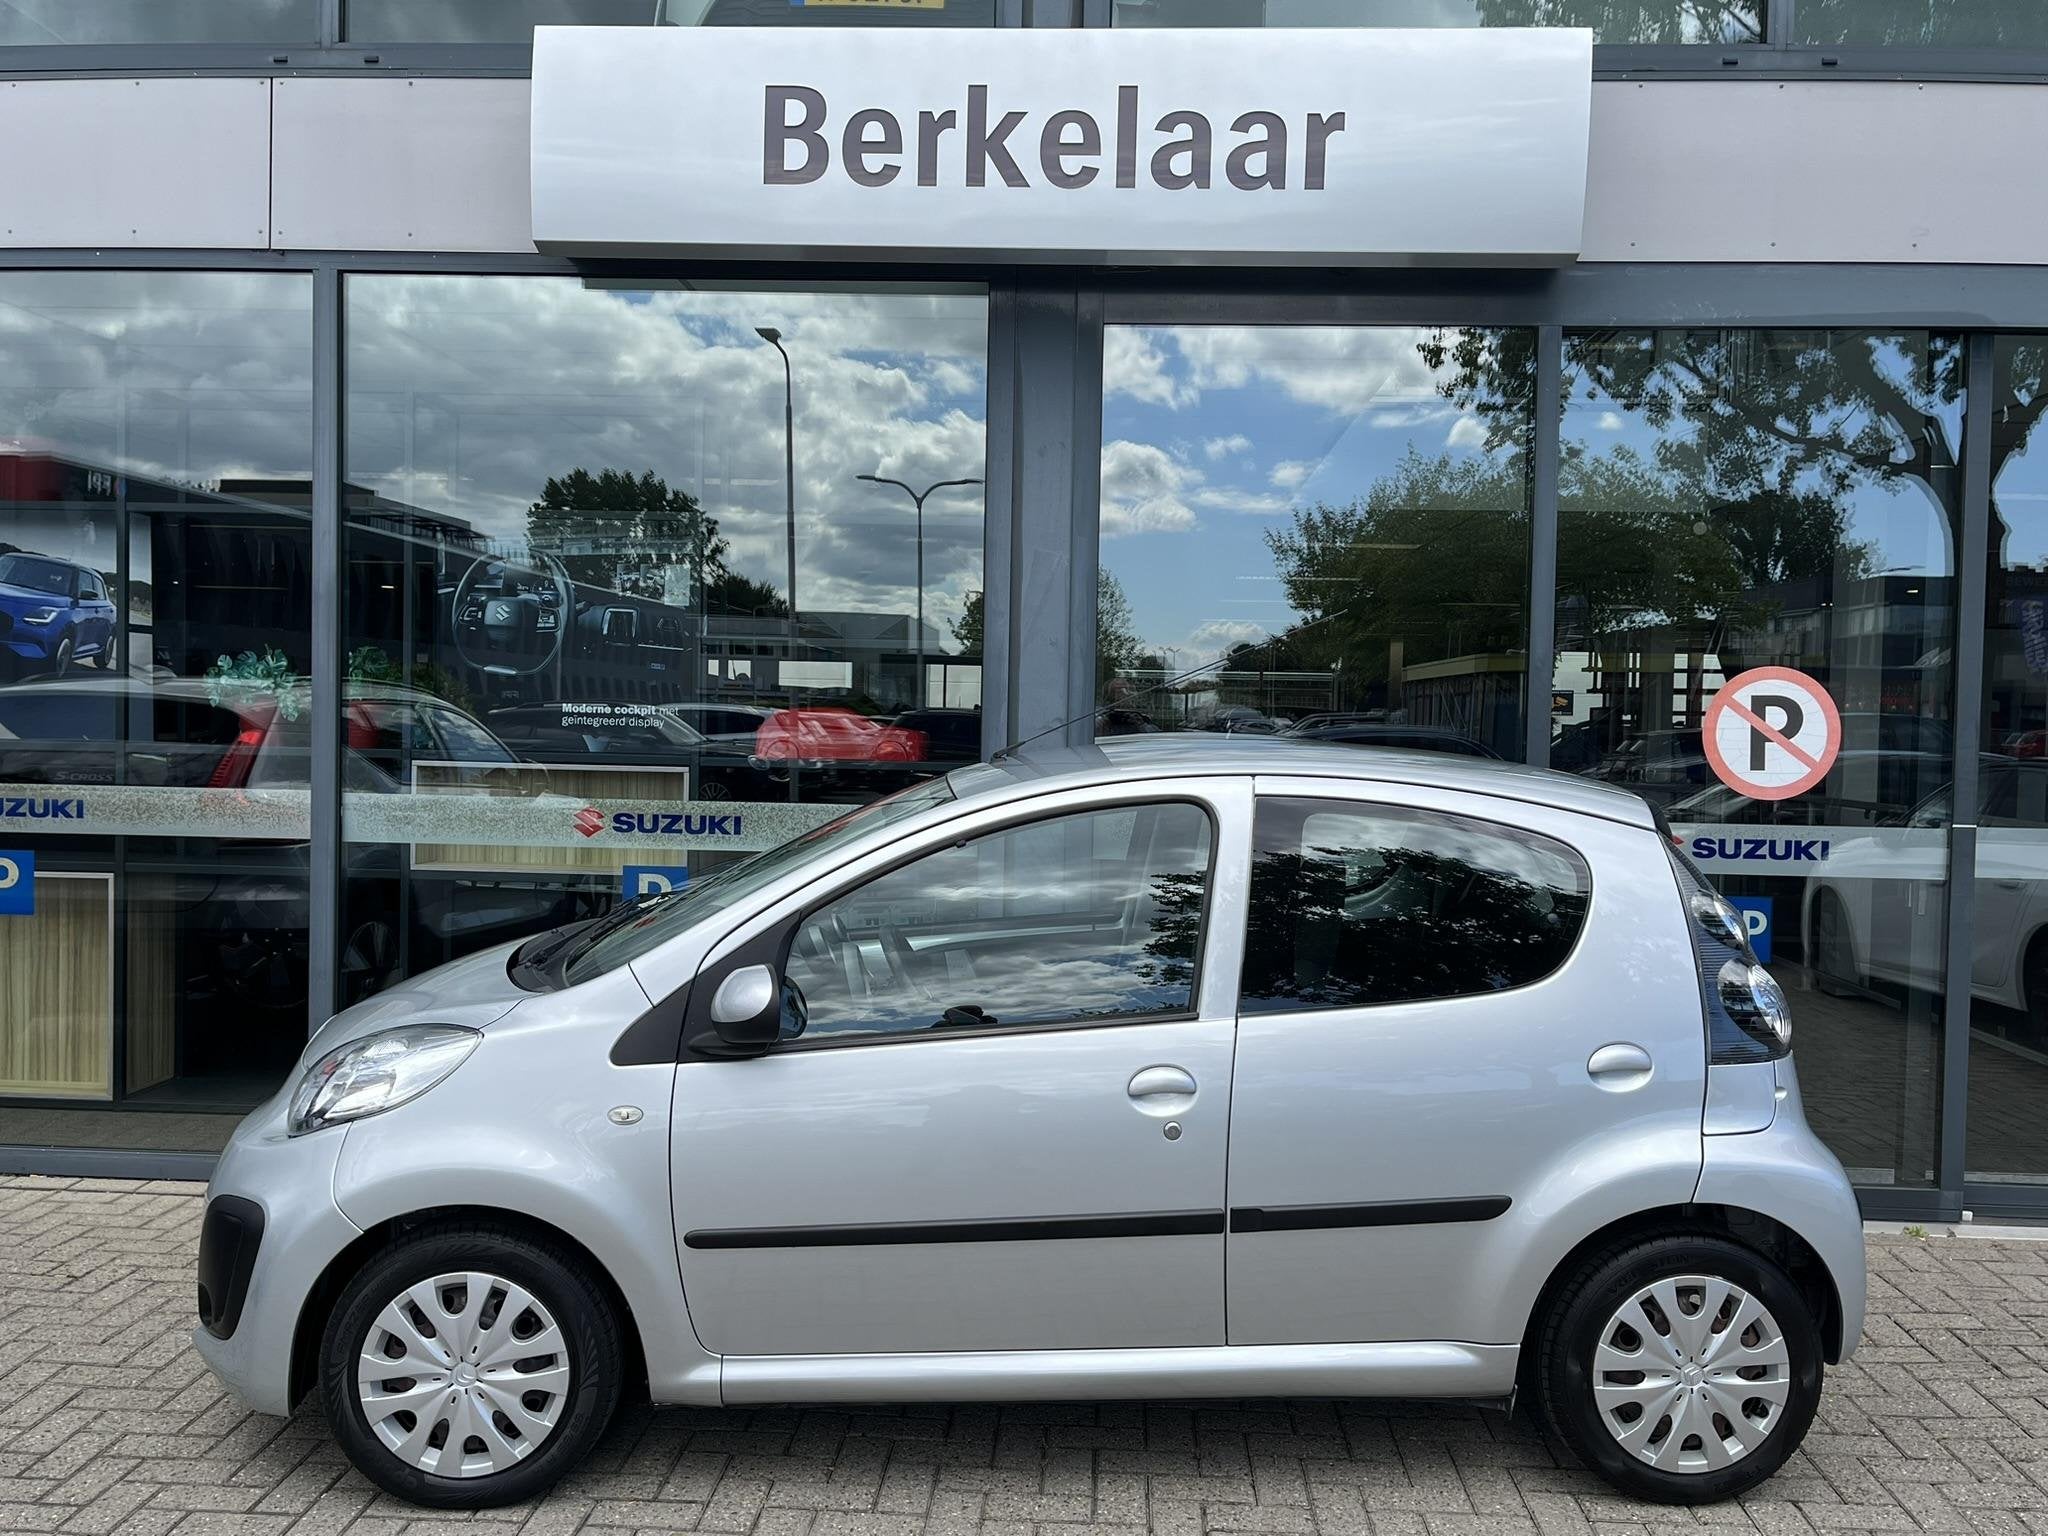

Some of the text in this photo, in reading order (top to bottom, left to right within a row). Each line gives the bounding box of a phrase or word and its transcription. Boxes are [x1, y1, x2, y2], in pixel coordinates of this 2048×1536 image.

[763, 85, 1346, 190] Berkelaar
[561, 703, 680, 717] Moderne cockpit met
[628, 716, 665, 729] display
[1749, 695, 1804, 771] P
[612, 813, 742, 836] SUZUKI
[1692, 838, 1830, 861] SUZUKI
